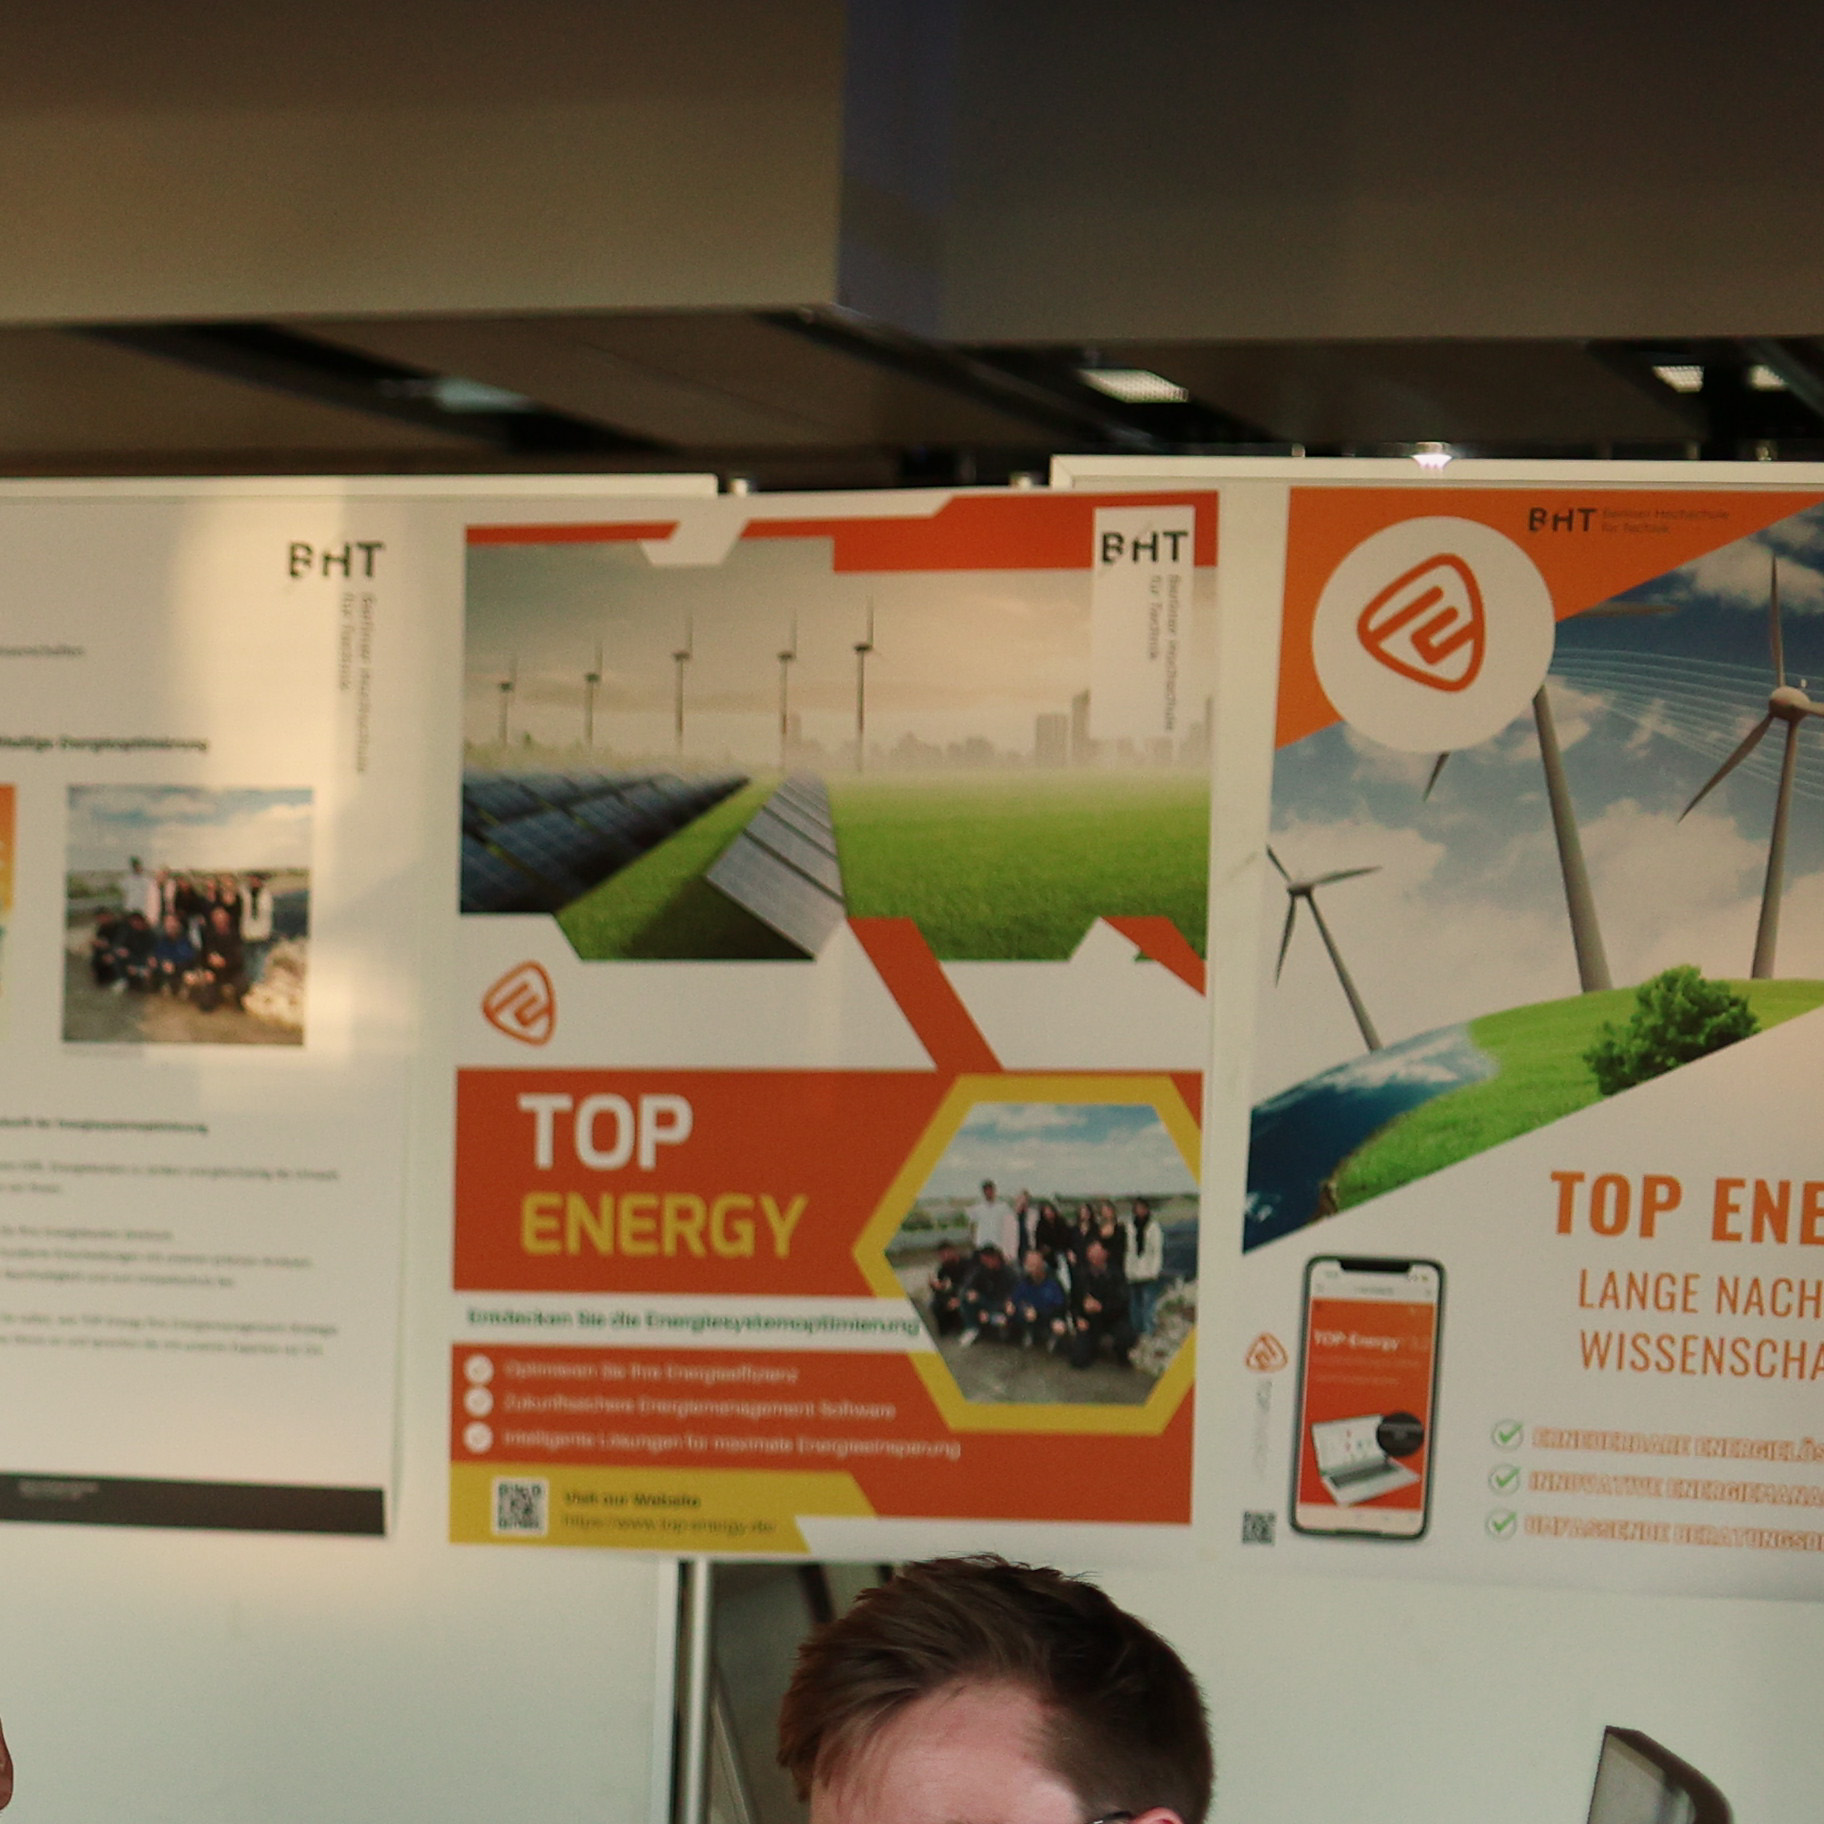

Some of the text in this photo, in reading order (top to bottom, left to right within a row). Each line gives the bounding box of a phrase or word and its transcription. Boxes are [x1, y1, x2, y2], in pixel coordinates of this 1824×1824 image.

[1528, 507, 1597, 533] BHT
[287, 540, 386, 579] BHT
[1101, 529, 1189, 565] BHT
[518, 1093, 694, 1172] TOP
[519, 1191, 810, 1259] ENERGY
[1549, 1170, 1683, 1239] TOP
[1578, 1269, 1701, 1314] LANGE
